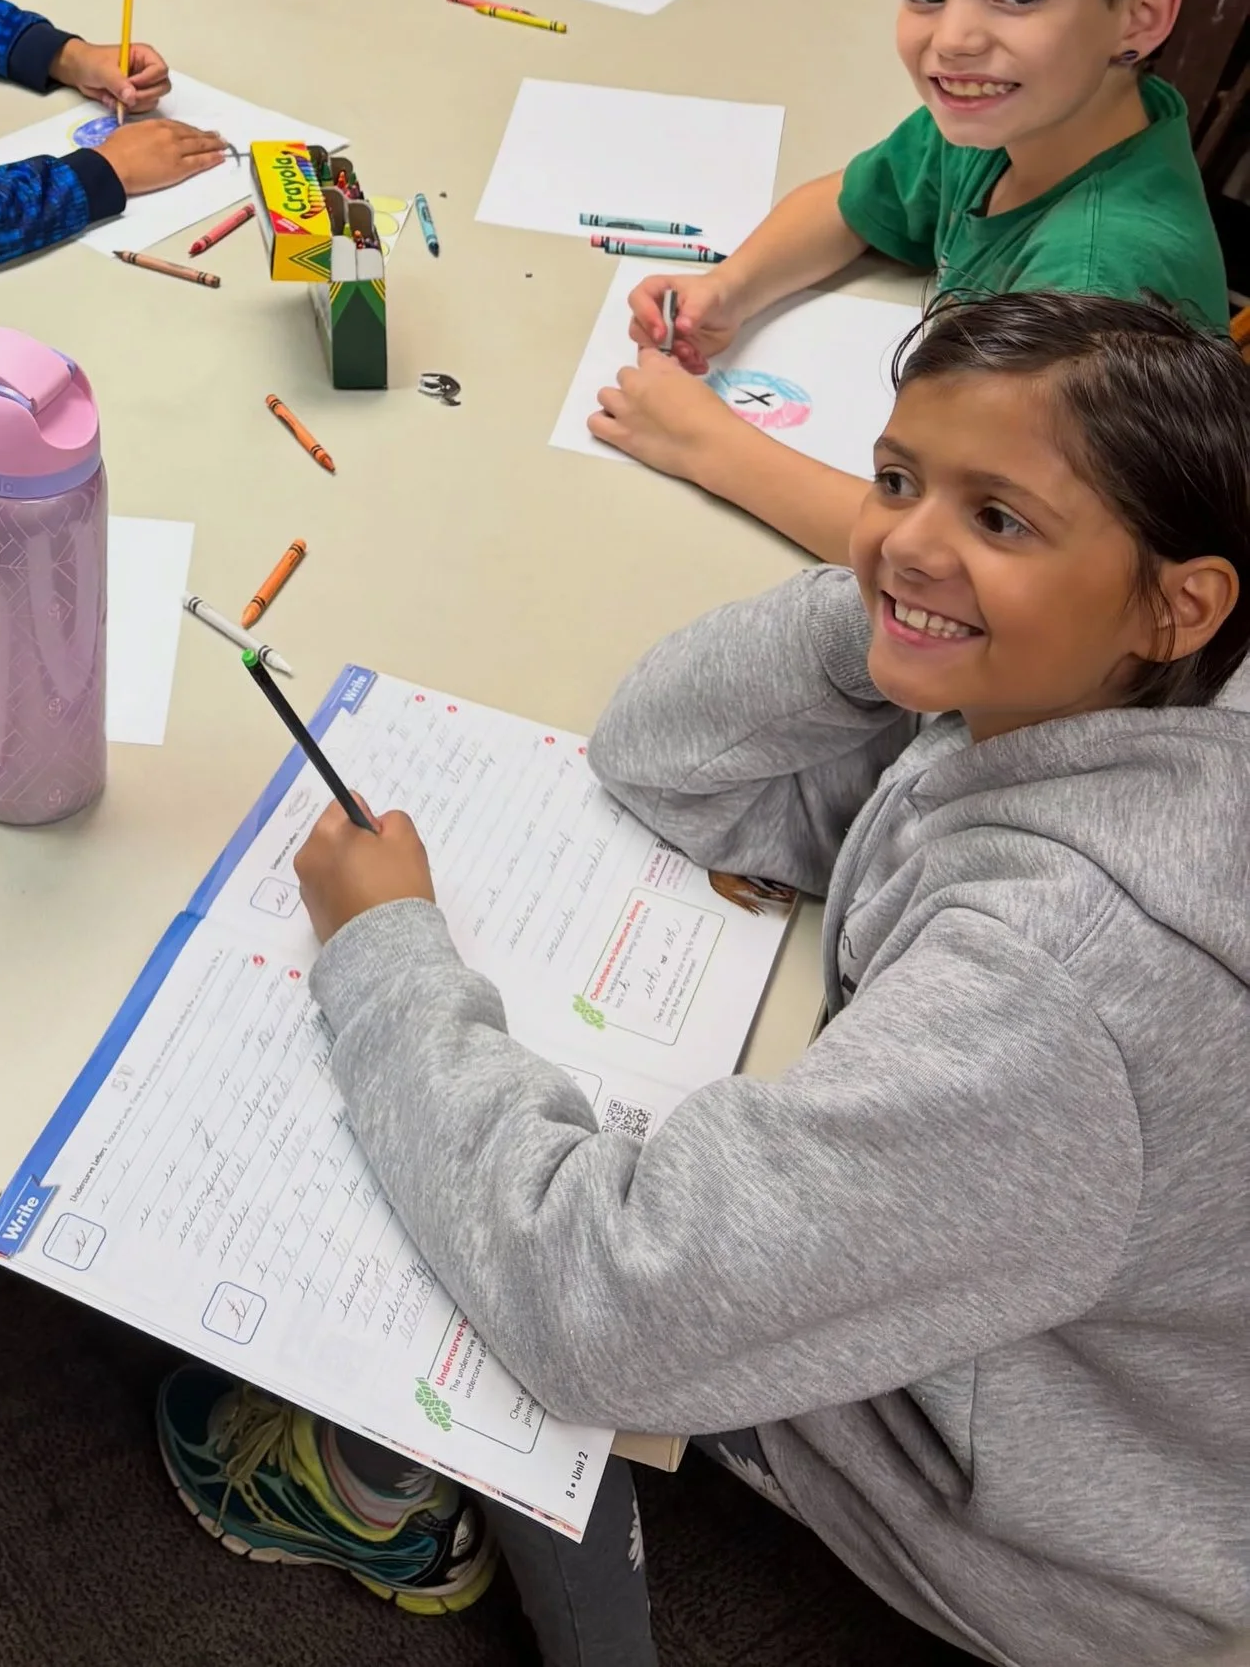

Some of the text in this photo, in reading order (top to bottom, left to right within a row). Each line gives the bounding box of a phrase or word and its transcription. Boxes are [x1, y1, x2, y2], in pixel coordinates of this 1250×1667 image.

[272, 156, 305, 213] Crayola
[341, 674, 368, 704] Write
[2, 1194, 40, 1242] Write
[436, 1315, 471, 1387] Undercurve-to-
[450, 1379, 460, 1391] The
[458, 1339, 481, 1377] undercurve
[466, 1359, 484, 1398] undercurve
[510, 1396, 525, 1419] Check
[525, 1396, 542, 1427] joining
[572, 1461, 584, 1480] Unit
[579, 1452, 588, 1460] 2
